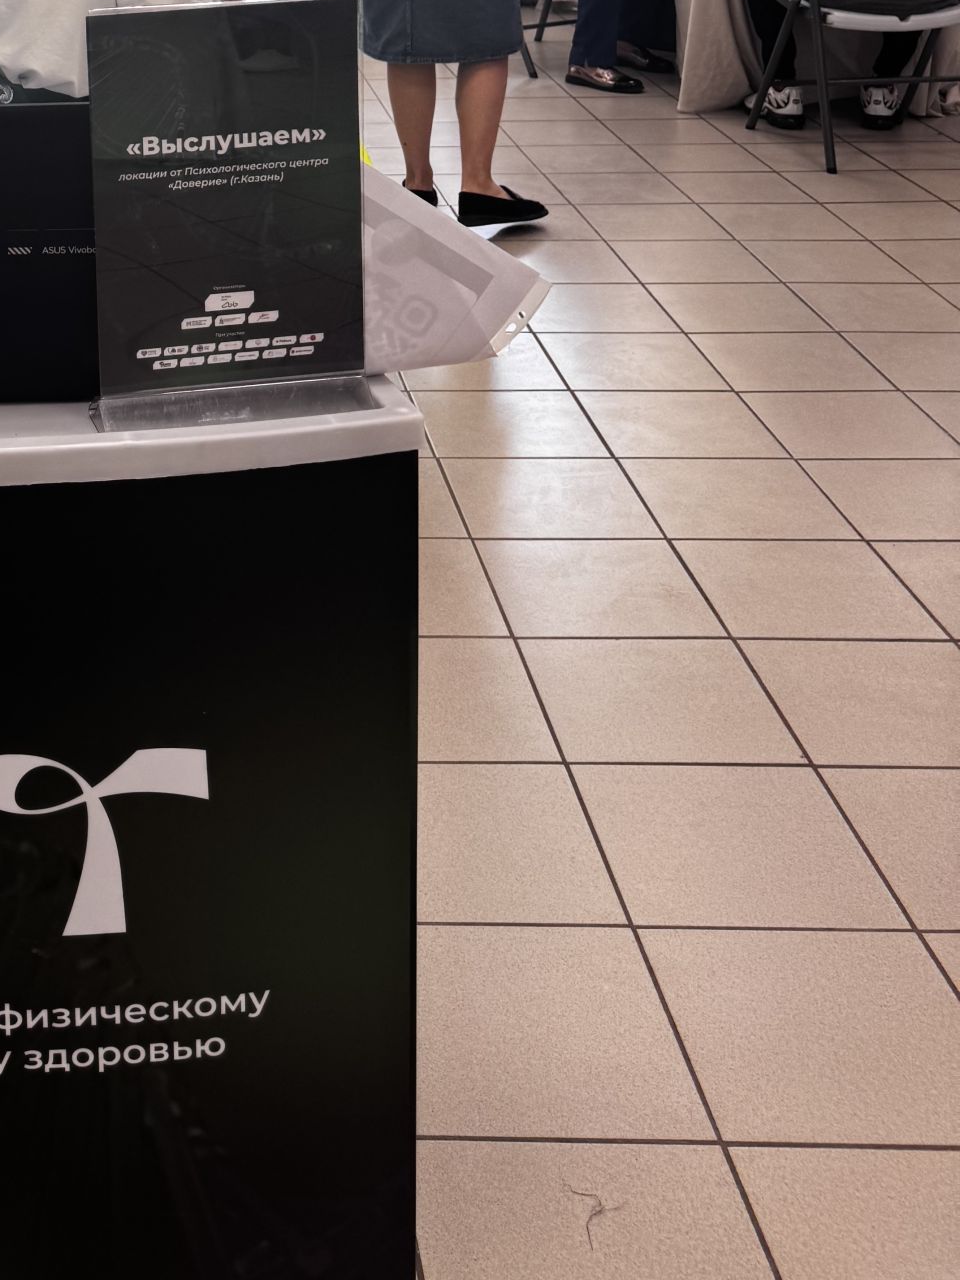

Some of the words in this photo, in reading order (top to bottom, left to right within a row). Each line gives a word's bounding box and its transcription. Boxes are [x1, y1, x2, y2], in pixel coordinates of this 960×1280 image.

[126, 128, 327, 156] «Выслушаем»
[118, 170, 167, 182] локации
[169, 169, 182, 177] от
[184, 160, 287, 176] Психологического
[289, 158, 329, 168] центра
[168, 179, 227, 191] «Доверие»
[230, 172, 284, 187] (г.Казань)
[42, 246, 66, 254] ASUS
[23, 1032, 227, 1074] здоровью
